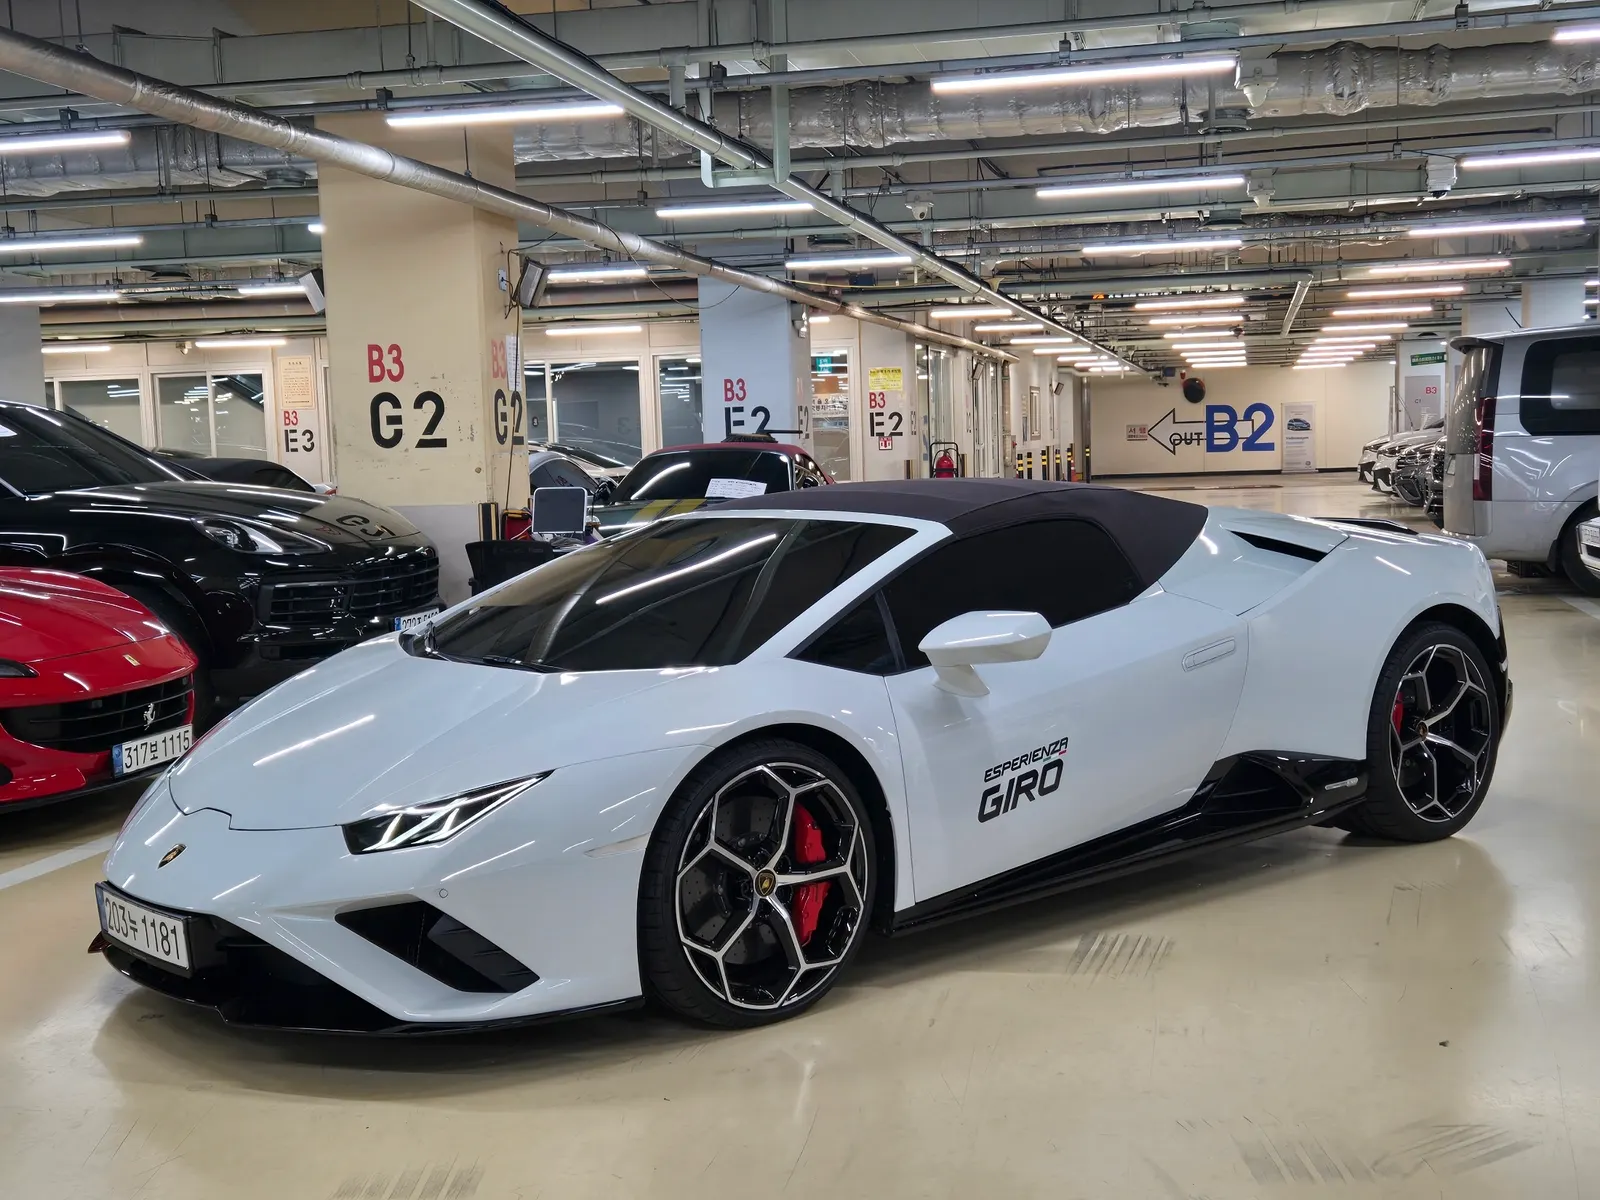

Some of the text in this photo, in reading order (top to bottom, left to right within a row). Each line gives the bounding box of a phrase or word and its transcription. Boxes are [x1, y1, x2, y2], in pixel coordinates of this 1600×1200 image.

[367, 343, 405, 383] B3
[723, 378, 746, 402] B3
[869, 392, 886, 409] B3
[1425, 386, 1437, 394] B3
[283, 410, 298, 426] B3
[370, 390, 447, 449] G2
[494, 388, 524, 445] G2
[869, 411, 903, 437] E2
[1205, 402, 1275, 453] B2
[284, 428, 315, 453] E3
[1169, 431, 1203, 447] OUT
[124, 729, 190, 769] 317보 1115
[983, 736, 1068, 783] ESPERIENZA
[977, 758, 1064, 823] GIRO
[105, 896, 180, 960] 203누 1181
